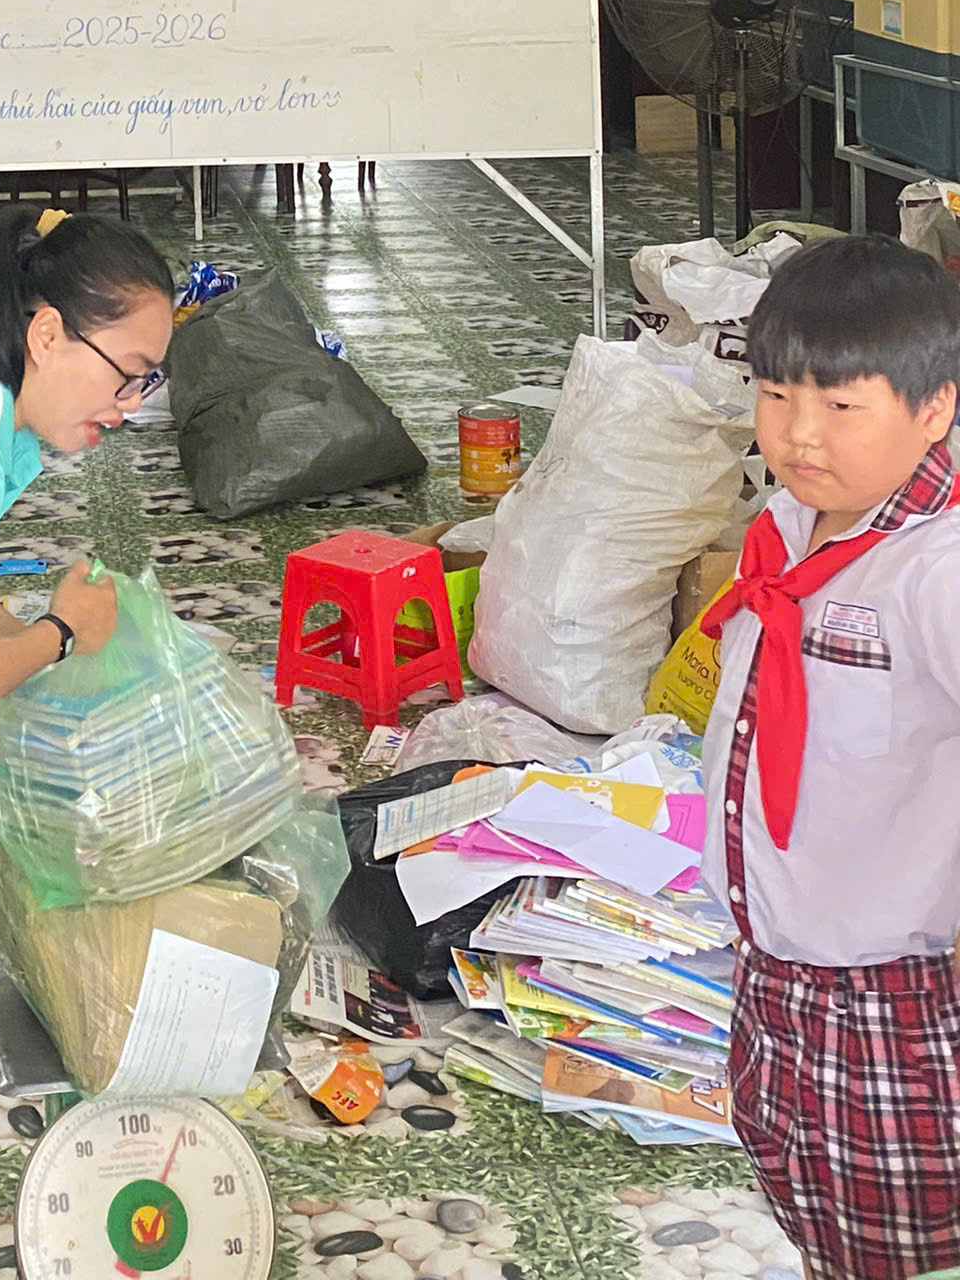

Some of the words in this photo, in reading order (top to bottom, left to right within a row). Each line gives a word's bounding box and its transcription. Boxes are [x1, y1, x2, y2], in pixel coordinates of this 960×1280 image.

[64, 13, 226, 47] 2025-2026
[37, 88, 75, 118] hai
[80, 93, 122, 117] của
[127, 88, 174, 135] giấy
[234, 83, 265, 112] vỏ
[680, 645, 710, 680] Maria
[331, 1090, 359, 1111] AFC
[118, 1113, 151, 1136] 100
[181, 1129, 197, 1148] 10
[75, 1141, 93, 1158] 90
[213, 1175, 235, 1196] 20
[48, 1192, 70, 1214] 80
[224, 1237, 242, 1256] 30
[53, 1258, 71, 1275] 70
